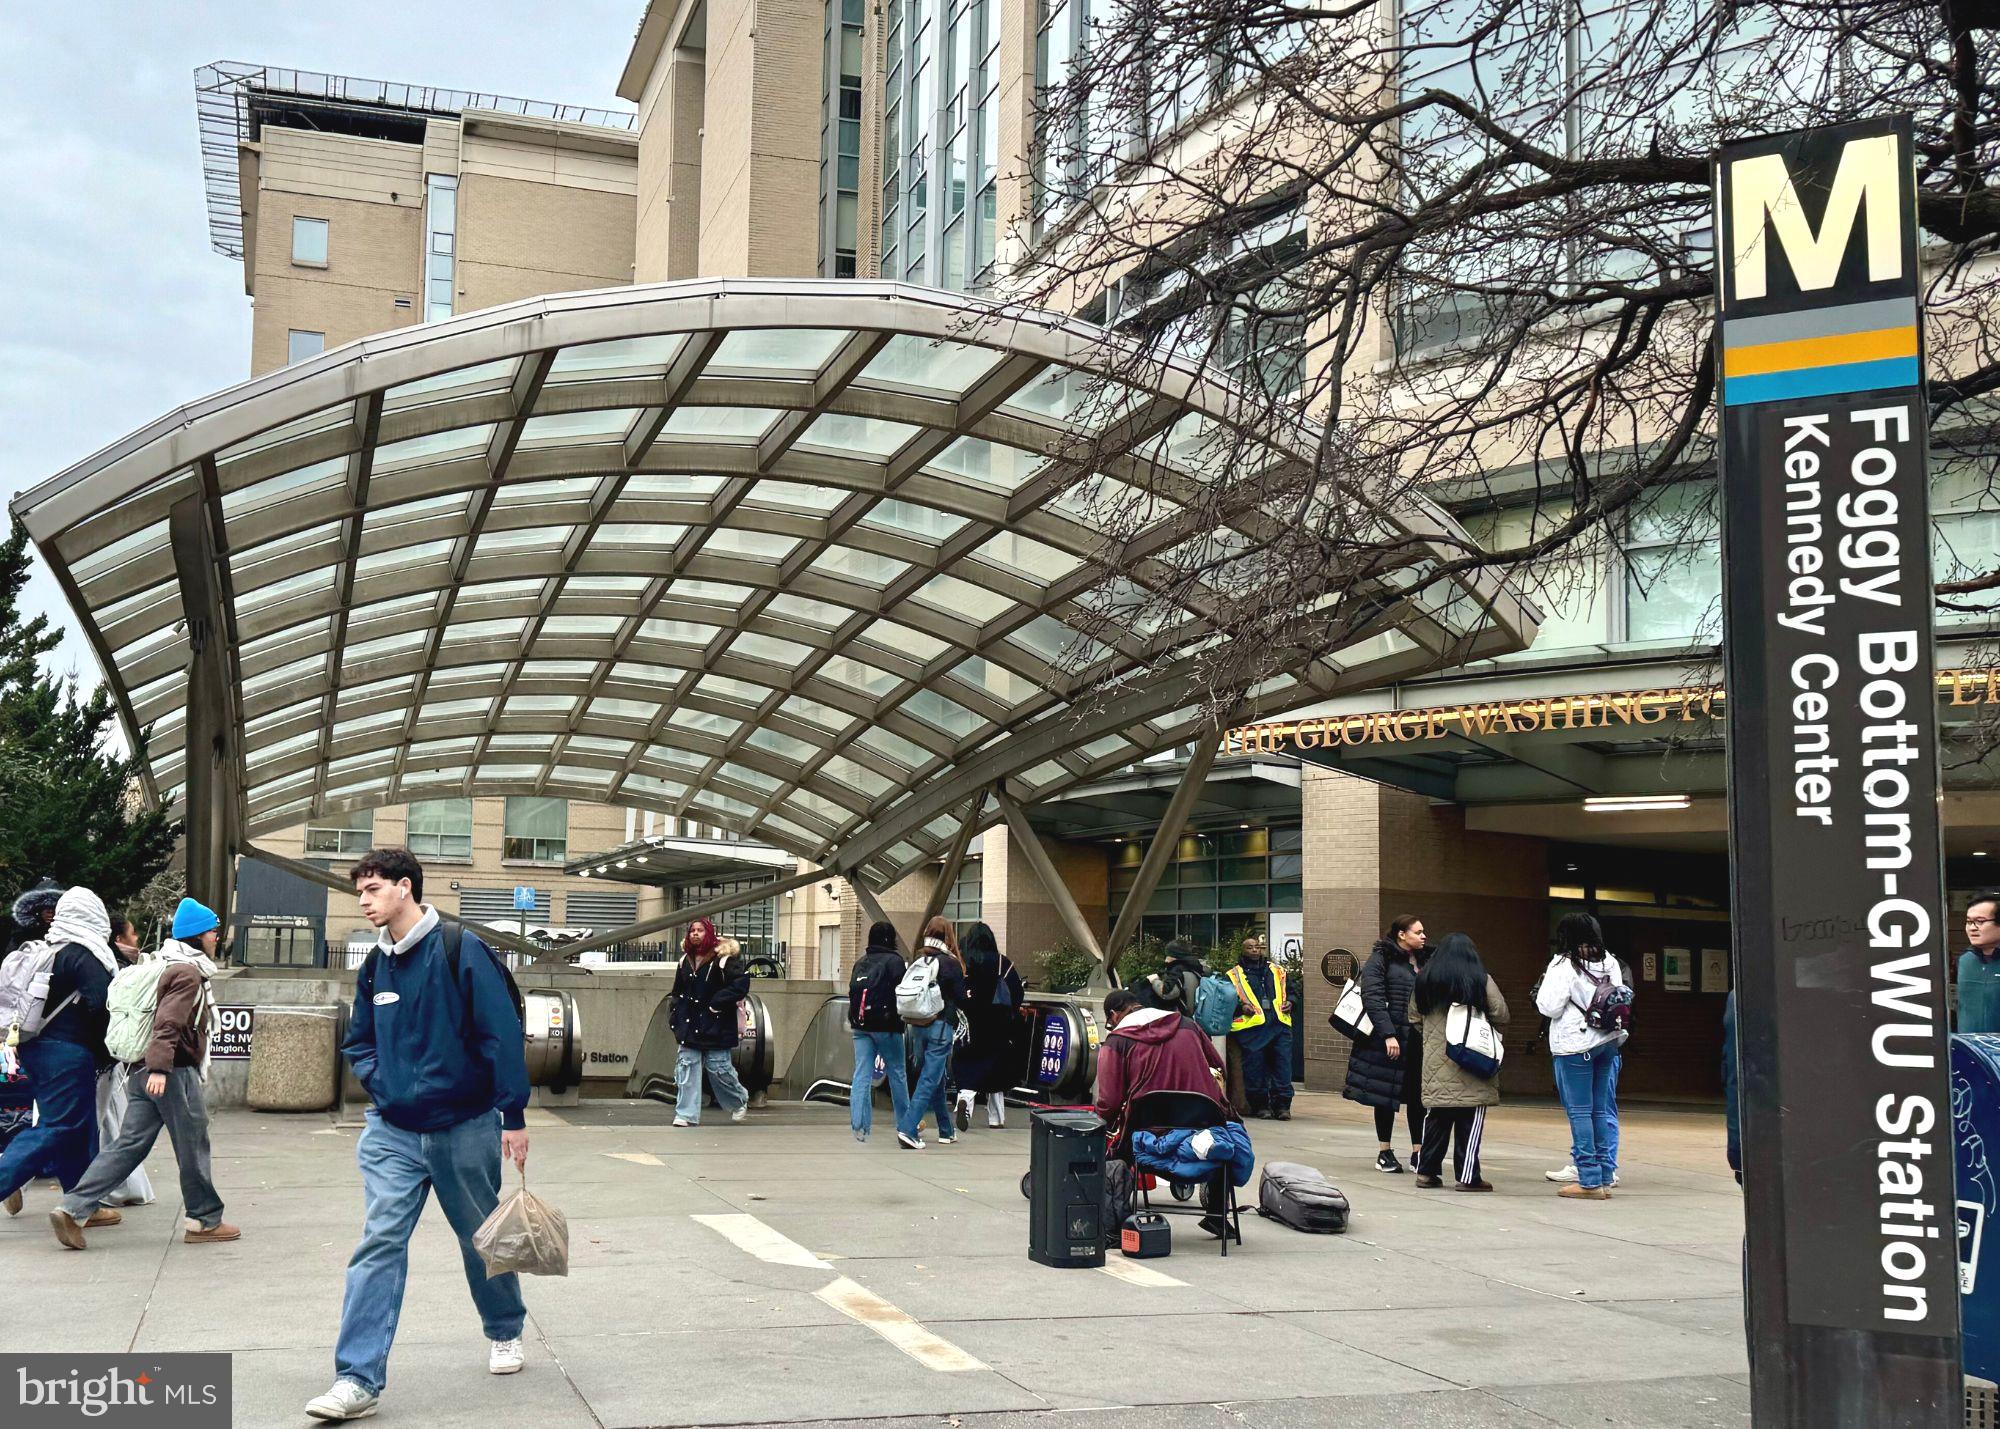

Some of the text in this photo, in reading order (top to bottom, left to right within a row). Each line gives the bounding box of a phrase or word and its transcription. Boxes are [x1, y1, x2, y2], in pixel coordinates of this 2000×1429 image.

[1731, 134, 1902, 300] M
[1777, 413, 1840, 826] Kennedy Center
[1223, 685, 1727, 757] THE GEORGE WASHINGTO
[1836, 405, 1940, 1323] Foggy Bottom-GWU Station
[211, 1032, 221, 1043] rd
[223, 1033, 235, 1043] St
[221, 1010, 251, 1031] 90
[210, 1044, 246, 1054] hington,
[590, 1052, 629, 1063] Station
